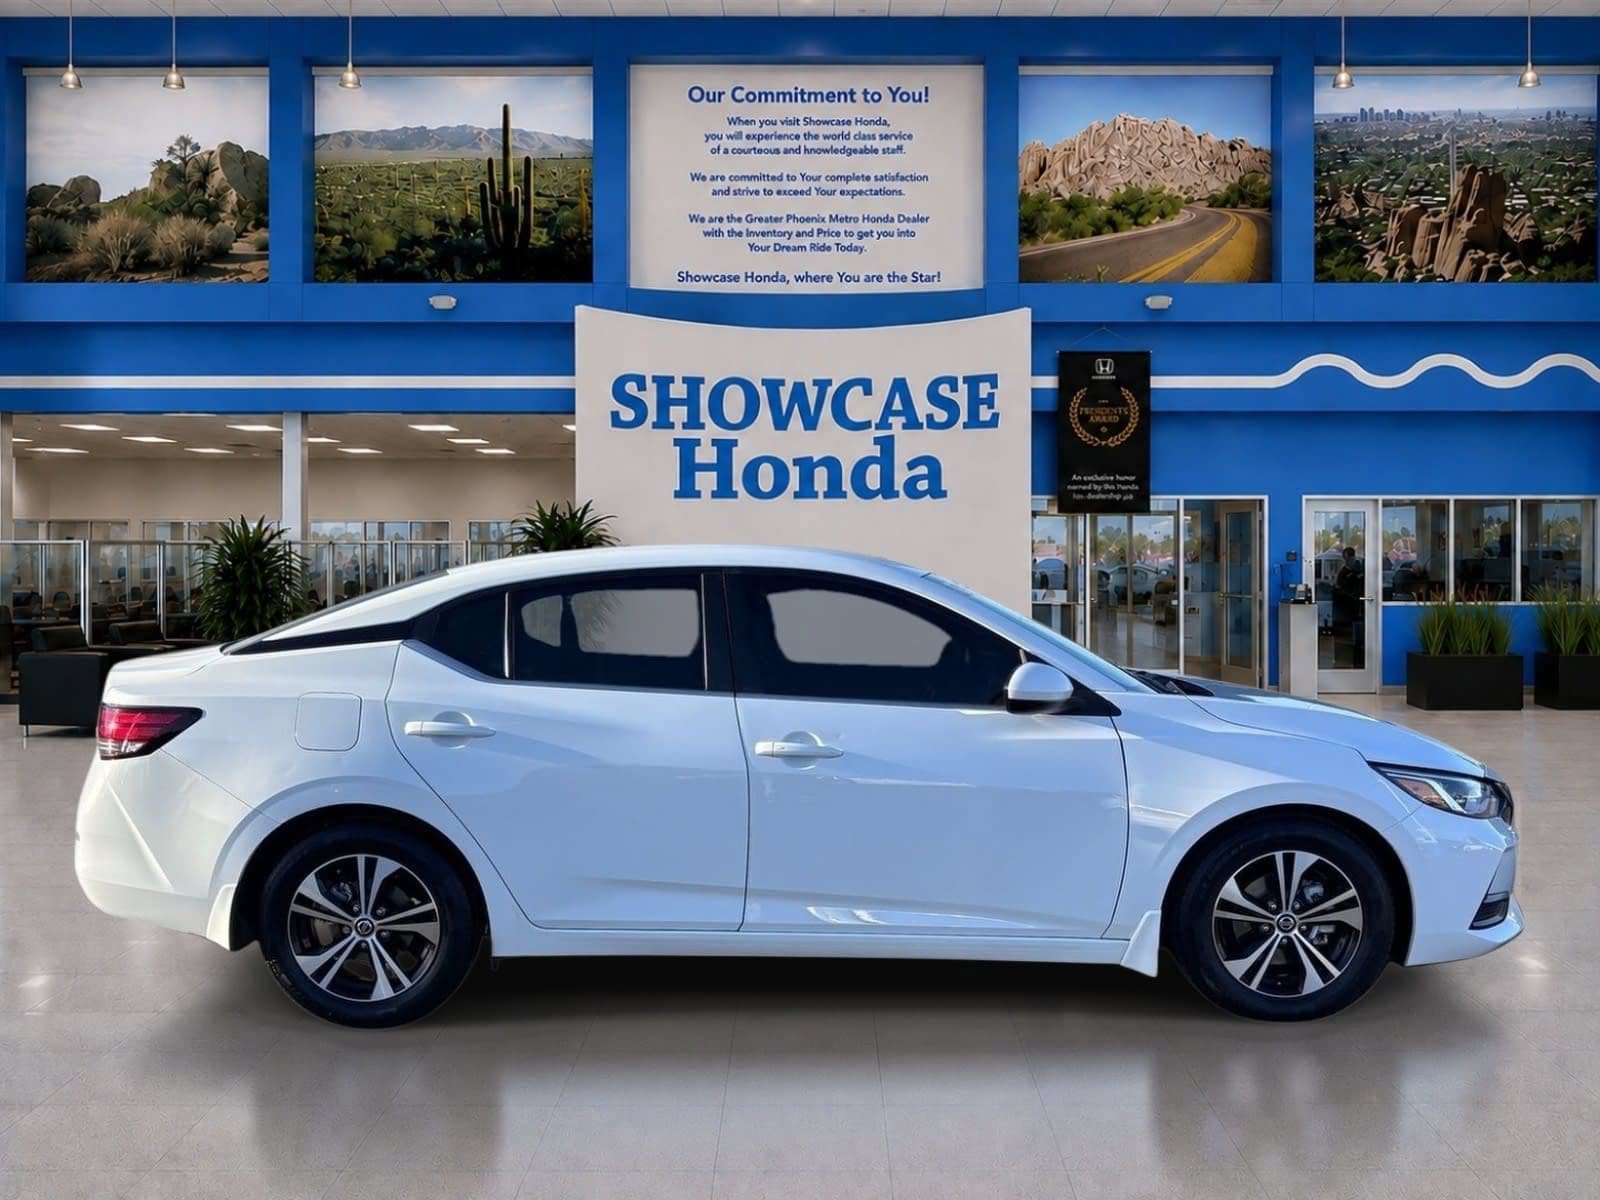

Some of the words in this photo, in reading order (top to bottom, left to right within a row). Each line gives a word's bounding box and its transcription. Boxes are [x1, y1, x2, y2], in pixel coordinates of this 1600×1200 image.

[687, 86, 726, 104] Our
[731, 86, 857, 104] Commitment
[862, 88, 883, 104] to
[887, 86, 930, 104] You!
[727, 116, 756, 127] When
[759, 118, 778, 129] you
[780, 116, 801, 127] visit
[803, 116, 853, 127] Showcase
[855, 116, 891, 128] Honda,
[705, 133, 723, 143] you
[726, 131, 743, 141] will
[745, 131, 801, 144] experience
[803, 131, 820, 141] the
[822, 131, 851, 141] world
[853, 131, 877, 141] class
[879, 131, 914, 141] service
[710, 144, 721, 155] of
[723, 147, 729, 155] a
[731, 145, 781, 155] courteous
[783, 144, 802, 155] and
[882, 144, 906, 155] staff.
[690, 172, 708, 183] We
[710, 174, 726, 182] are
[728, 172, 784, 183] committed
[786, 173, 798, 183] to
[800, 172, 822, 183] Your
[825, 172, 872, 185] complete
[874, 172, 929, 183] satisfaction
[711, 186, 731, 197] and
[733, 187, 760, 197] strive
[763, 188, 774, 197] to
[776, 186, 812, 197] exceed
[814, 186, 838, 197] Your
[840, 187, 906, 199] expectations.
[689, 213, 706, 224] We
[708, 216, 725, 224] are
[727, 214, 743, 224] the
[745, 213, 784, 224] Greater
[786, 213, 826, 224] Phoenix
[829, 213, 860, 224] Metro
[862, 213, 895, 224] Honda
[897, 213, 930, 224] Dealer
[703, 228, 725, 238] with
[727, 228, 743, 238] the
[746, 228, 793, 241] Inventory
[795, 228, 815, 238] and
[817, 228, 842, 238] Price
[844, 229, 855, 238] to
[857, 229, 875, 241] get
[876, 230, 895, 241] you
[897, 228, 917, 238] into
[748, 242, 771, 253] Your
[773, 242, 807, 253] Dream
[810, 242, 832, 253] Ride
[834, 242, 867, 255] Today.
[677, 270, 741, 284] Showcase
[744, 270, 790, 285] Honda,
[794, 270, 834, 284] where
[836, 271, 861, 284] You
[864, 274, 884, 284] are
[887, 270, 908, 284] the
[911, 270, 941, 284] Star!
[610, 373, 1000, 431] SHOWCASE
[673, 434, 948, 500] Honda
